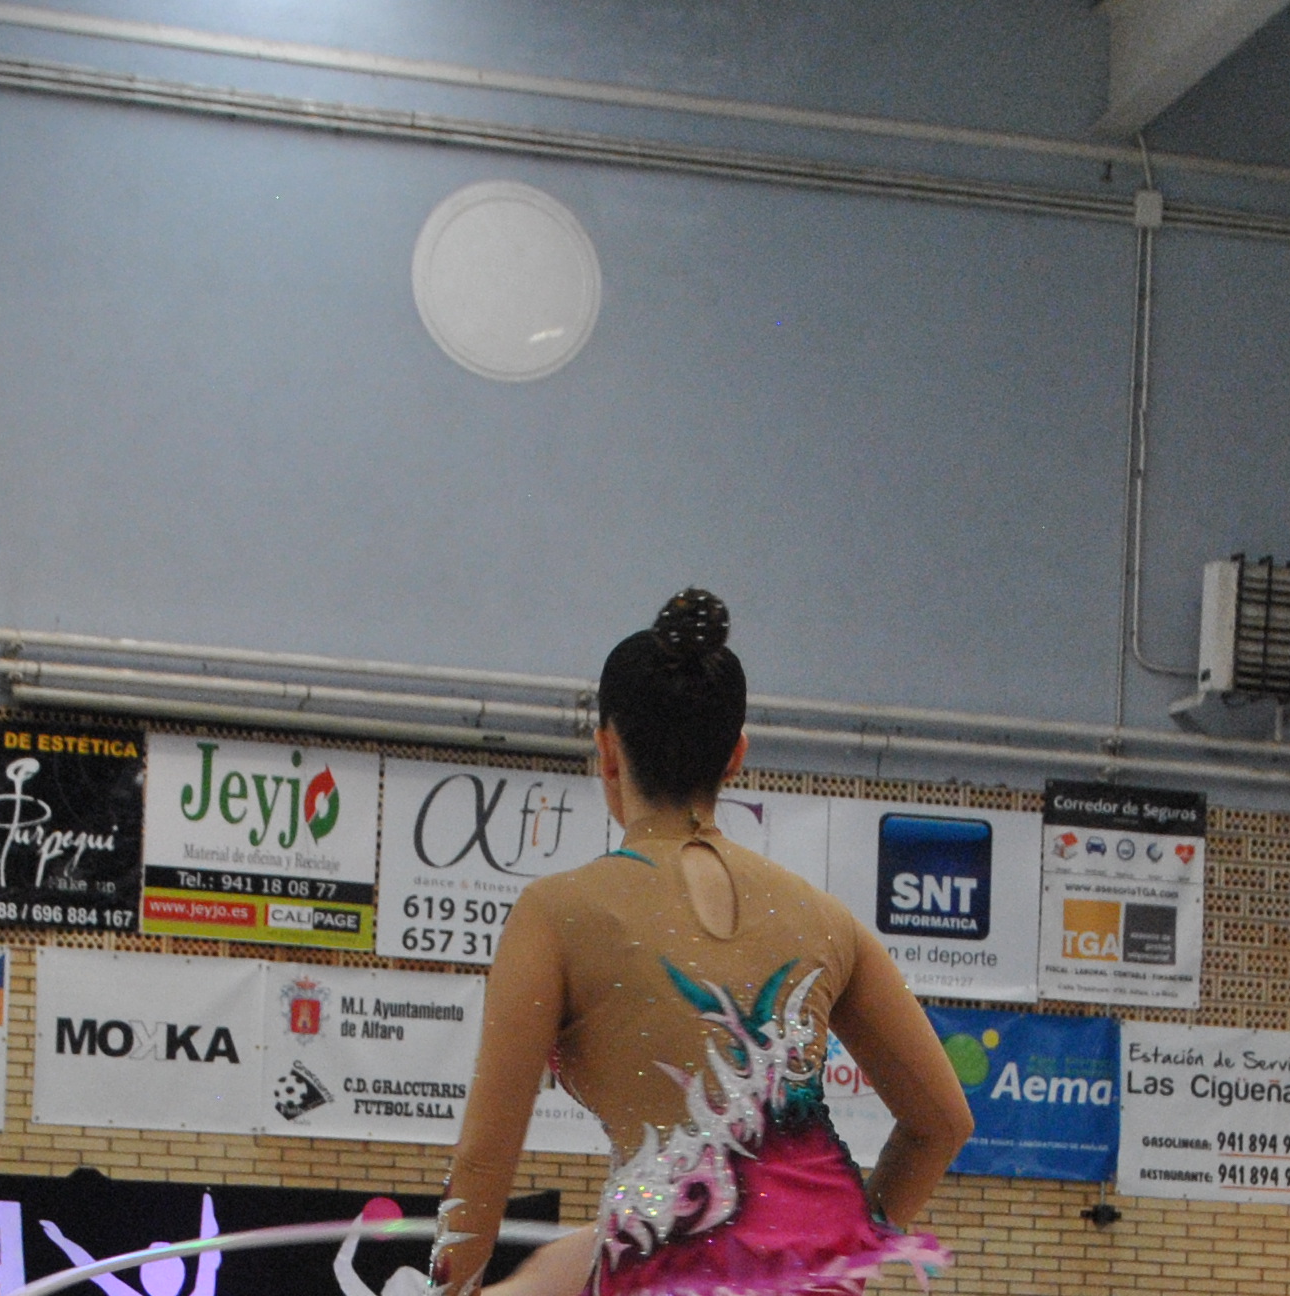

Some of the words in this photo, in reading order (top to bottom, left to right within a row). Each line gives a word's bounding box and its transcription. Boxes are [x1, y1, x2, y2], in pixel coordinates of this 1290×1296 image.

[4, 731, 32, 750] DE
[1053, 794, 1118, 816] Corredor
[1122, 802, 1139, 816] de
[1143, 802, 1197, 823] Seguros
[183, 843, 230, 863] Material
[233, 850, 246, 864] de
[221, 874, 254, 893] 941
[261, 877, 283, 894] 18
[288, 880, 310, 897] 08
[316, 882, 337, 899] 77
[413, 875, 455, 888] dance
[474, 880, 519, 894] fitness
[890, 871, 978, 914] SNT
[32, 904, 63, 922] 696
[67, 907, 98, 925] 884
[103, 909, 133, 927] 167
[149, 900, 249, 920] www.jeyjo.es
[403, 894, 456, 921] 619
[464, 899, 514, 925] 507
[890, 912, 978, 931] INFORMATICA
[402, 926, 454, 953] 657
[462, 931, 493, 957] 31
[1063, 929, 1120, 957] TGA
[888, 946, 899, 960] n
[905, 945, 921, 961] el
[927, 946, 998, 968] deporte
[341, 996, 368, 1016] M.I.
[373, 997, 464, 1022] Ayuntamiento
[341, 1020, 357, 1037] de
[361, 1020, 405, 1041] Alfaro
[1128, 1042, 1204, 1067] Estación
[1213, 1050, 1235, 1069] de
[343, 1077, 369, 1094] C.D.
[372, 1079, 466, 1099] GRACCURRIS
[990, 1061, 1112, 1106] Aema
[1127, 1070, 1175, 1096] Las
[354, 1099, 414, 1117] FUTBOL
[416, 1102, 455, 1119] SALA
[1216, 1131, 1244, 1152] 941
[1248, 1133, 1277, 1153] 894
[1218, 1163, 1245, 1184] 941
[1249, 1165, 1279, 1186] 894
